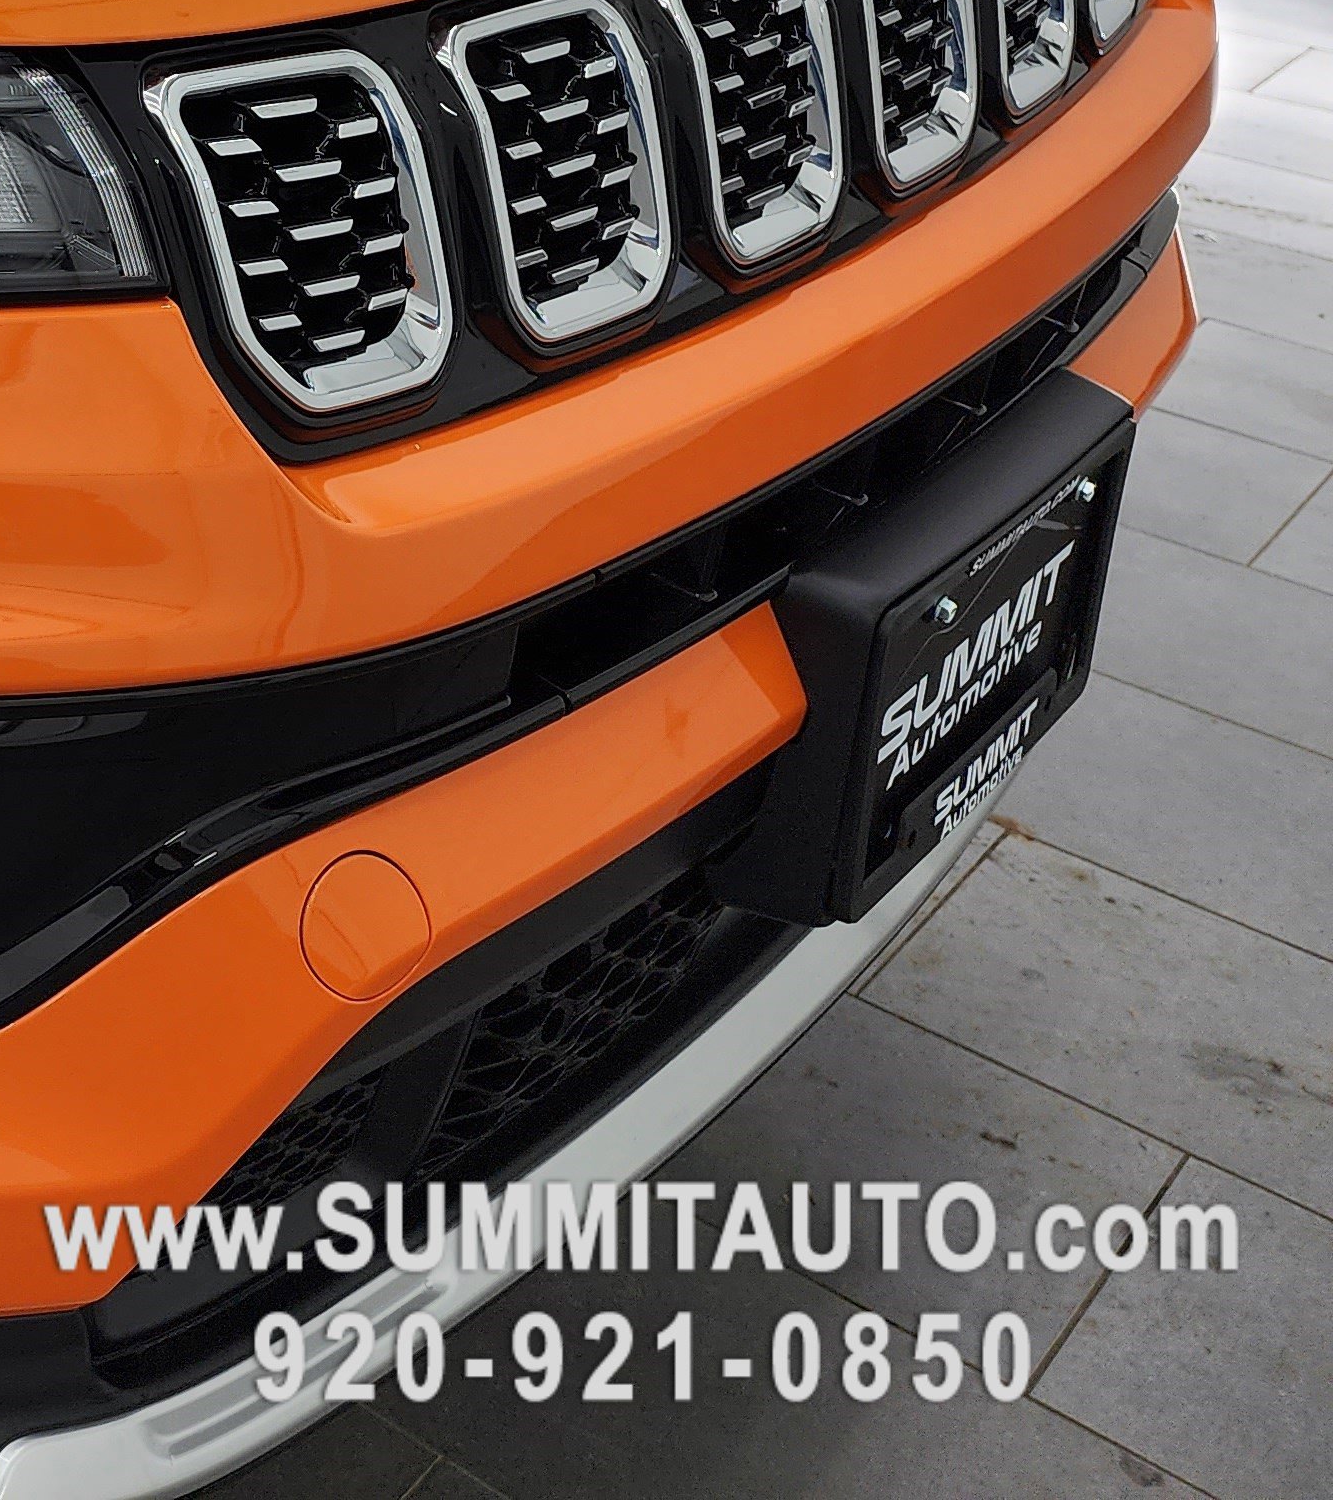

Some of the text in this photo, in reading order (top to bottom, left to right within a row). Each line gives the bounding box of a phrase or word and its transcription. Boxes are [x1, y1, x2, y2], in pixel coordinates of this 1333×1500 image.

[877, 539, 1075, 765] SUMMIT
[886, 618, 1042, 792] Automotive
[933, 697, 1039, 827] SUMMIT
[939, 744, 1024, 841] Automotive
